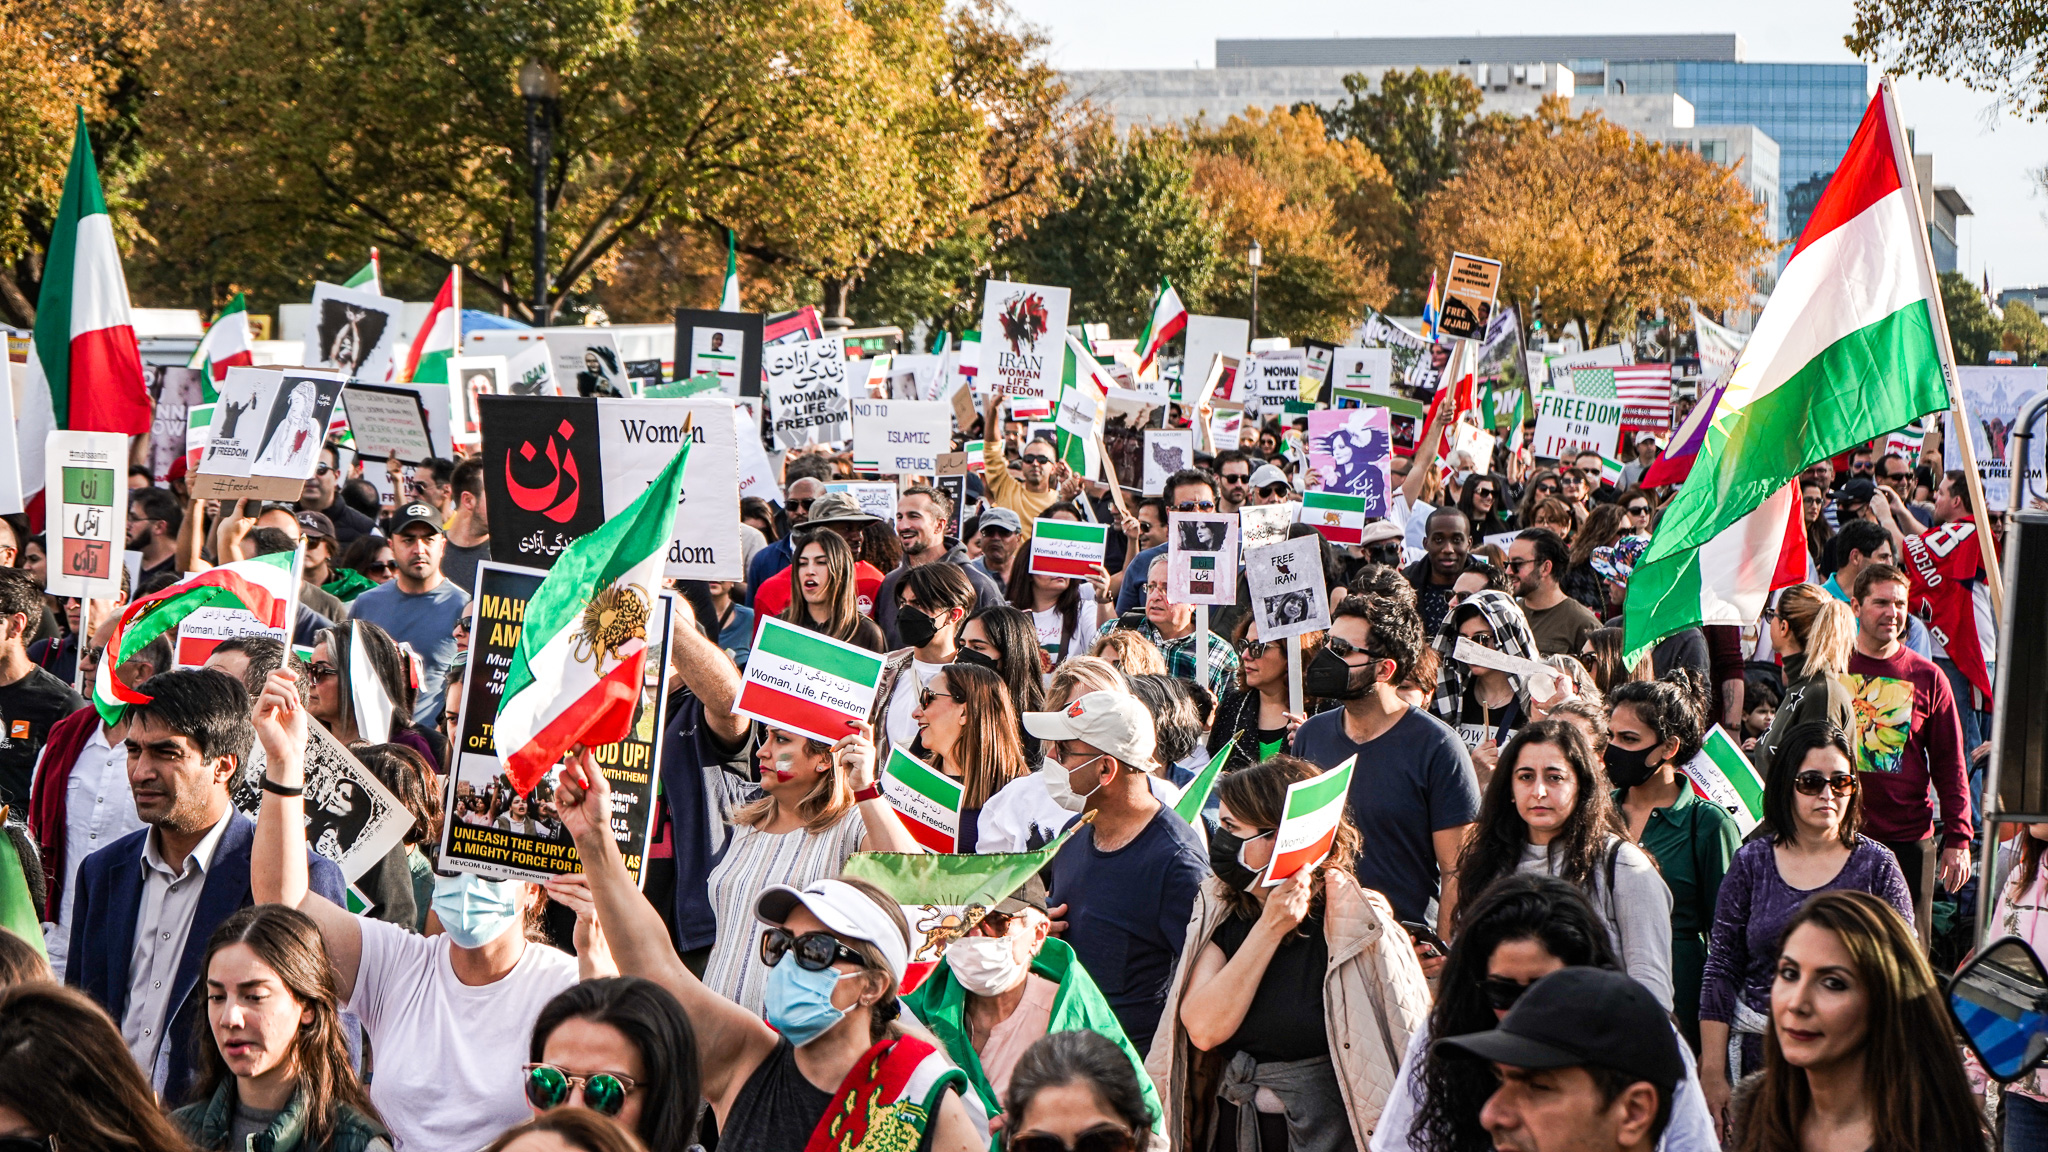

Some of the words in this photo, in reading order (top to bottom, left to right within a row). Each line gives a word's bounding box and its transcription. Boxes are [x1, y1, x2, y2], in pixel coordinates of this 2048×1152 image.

[1446, 306, 1467, 318] FREE
[817, 339, 837, 359] زن
[769, 344, 809, 376] آزادی
[999, 351, 1043, 370] IRAN
[522, 362, 547, 386] IRAN
[998, 367, 1041, 379] WOMAN
[1263, 366, 1298, 377] WOMAN
[1403, 365, 1439, 389] LIFE
[1007, 377, 1030, 387] LIFE
[1268, 379, 1297, 390] LIFE
[779, 388, 838, 405] WOMAN
[991, 384, 1043, 397] FREEDOM
[1260, 395, 1297, 406] REEDOM
[795, 401, 827, 416] LIFE
[855, 404, 871, 417] NO
[875, 405, 888, 417] TO
[1541, 396, 1621, 426] FREEDOM
[776, 411, 848, 432] FREEDOM
[1566, 422, 1589, 436] FOR
[620, 419, 706, 443] Womn
[887, 430, 931, 444] ISLAMIC
[216, 447, 249, 458] FREEDOM
[505, 418, 580, 524] زن
[895, 457, 937, 471] REPUBL
[1989, 468, 2042, 479] FREEOM
[212, 479, 260, 494] #freedom
[1925, 521, 1976, 558] 8
[1034, 547, 1059, 556] Woman,
[1060, 550, 1074, 558] Life,
[1074, 551, 1102, 559] Freedom
[1271, 553, 1295, 566] FREE
[1903, 533, 1943, 588] OVECHK
[1274, 573, 1297, 585] IRAN
[481, 594, 526, 622] MAH
[182, 623, 215, 636] Woman,
[217, 626, 237, 637] Life,
[239, 627, 282, 641] Freedom
[493, 669, 509, 681] by
[751, 667, 792, 692] Woman,
[795, 682, 817, 700] Life,
[820, 691, 866, 715] Freedom
[469, 736, 487, 748] OF
[622, 742, 650, 769] UP!
[600, 767, 621, 781] WITH
[622, 770, 648, 784] THEM!
[1686, 761, 1711, 792] Woman,
[610, 790, 638, 804] slamic
[611, 801, 629, 814] blic!
[884, 792, 903, 809] oman,
[904, 803, 920, 819] Life,
[921, 811, 955, 834] Freedom
[611, 817, 629, 831] U.S.
[453, 826, 508, 847] UNLEASH
[510, 836, 533, 851] THE
[535, 842, 566, 857] FURY
[453, 841, 462, 852] A
[464, 842, 510, 861] MIGHTY
[512, 851, 548, 868] FORCE
[550, 858, 572, 872] FOR
[627, 854, 641, 869] AS
[450, 859, 492, 871] REVCOM.US
